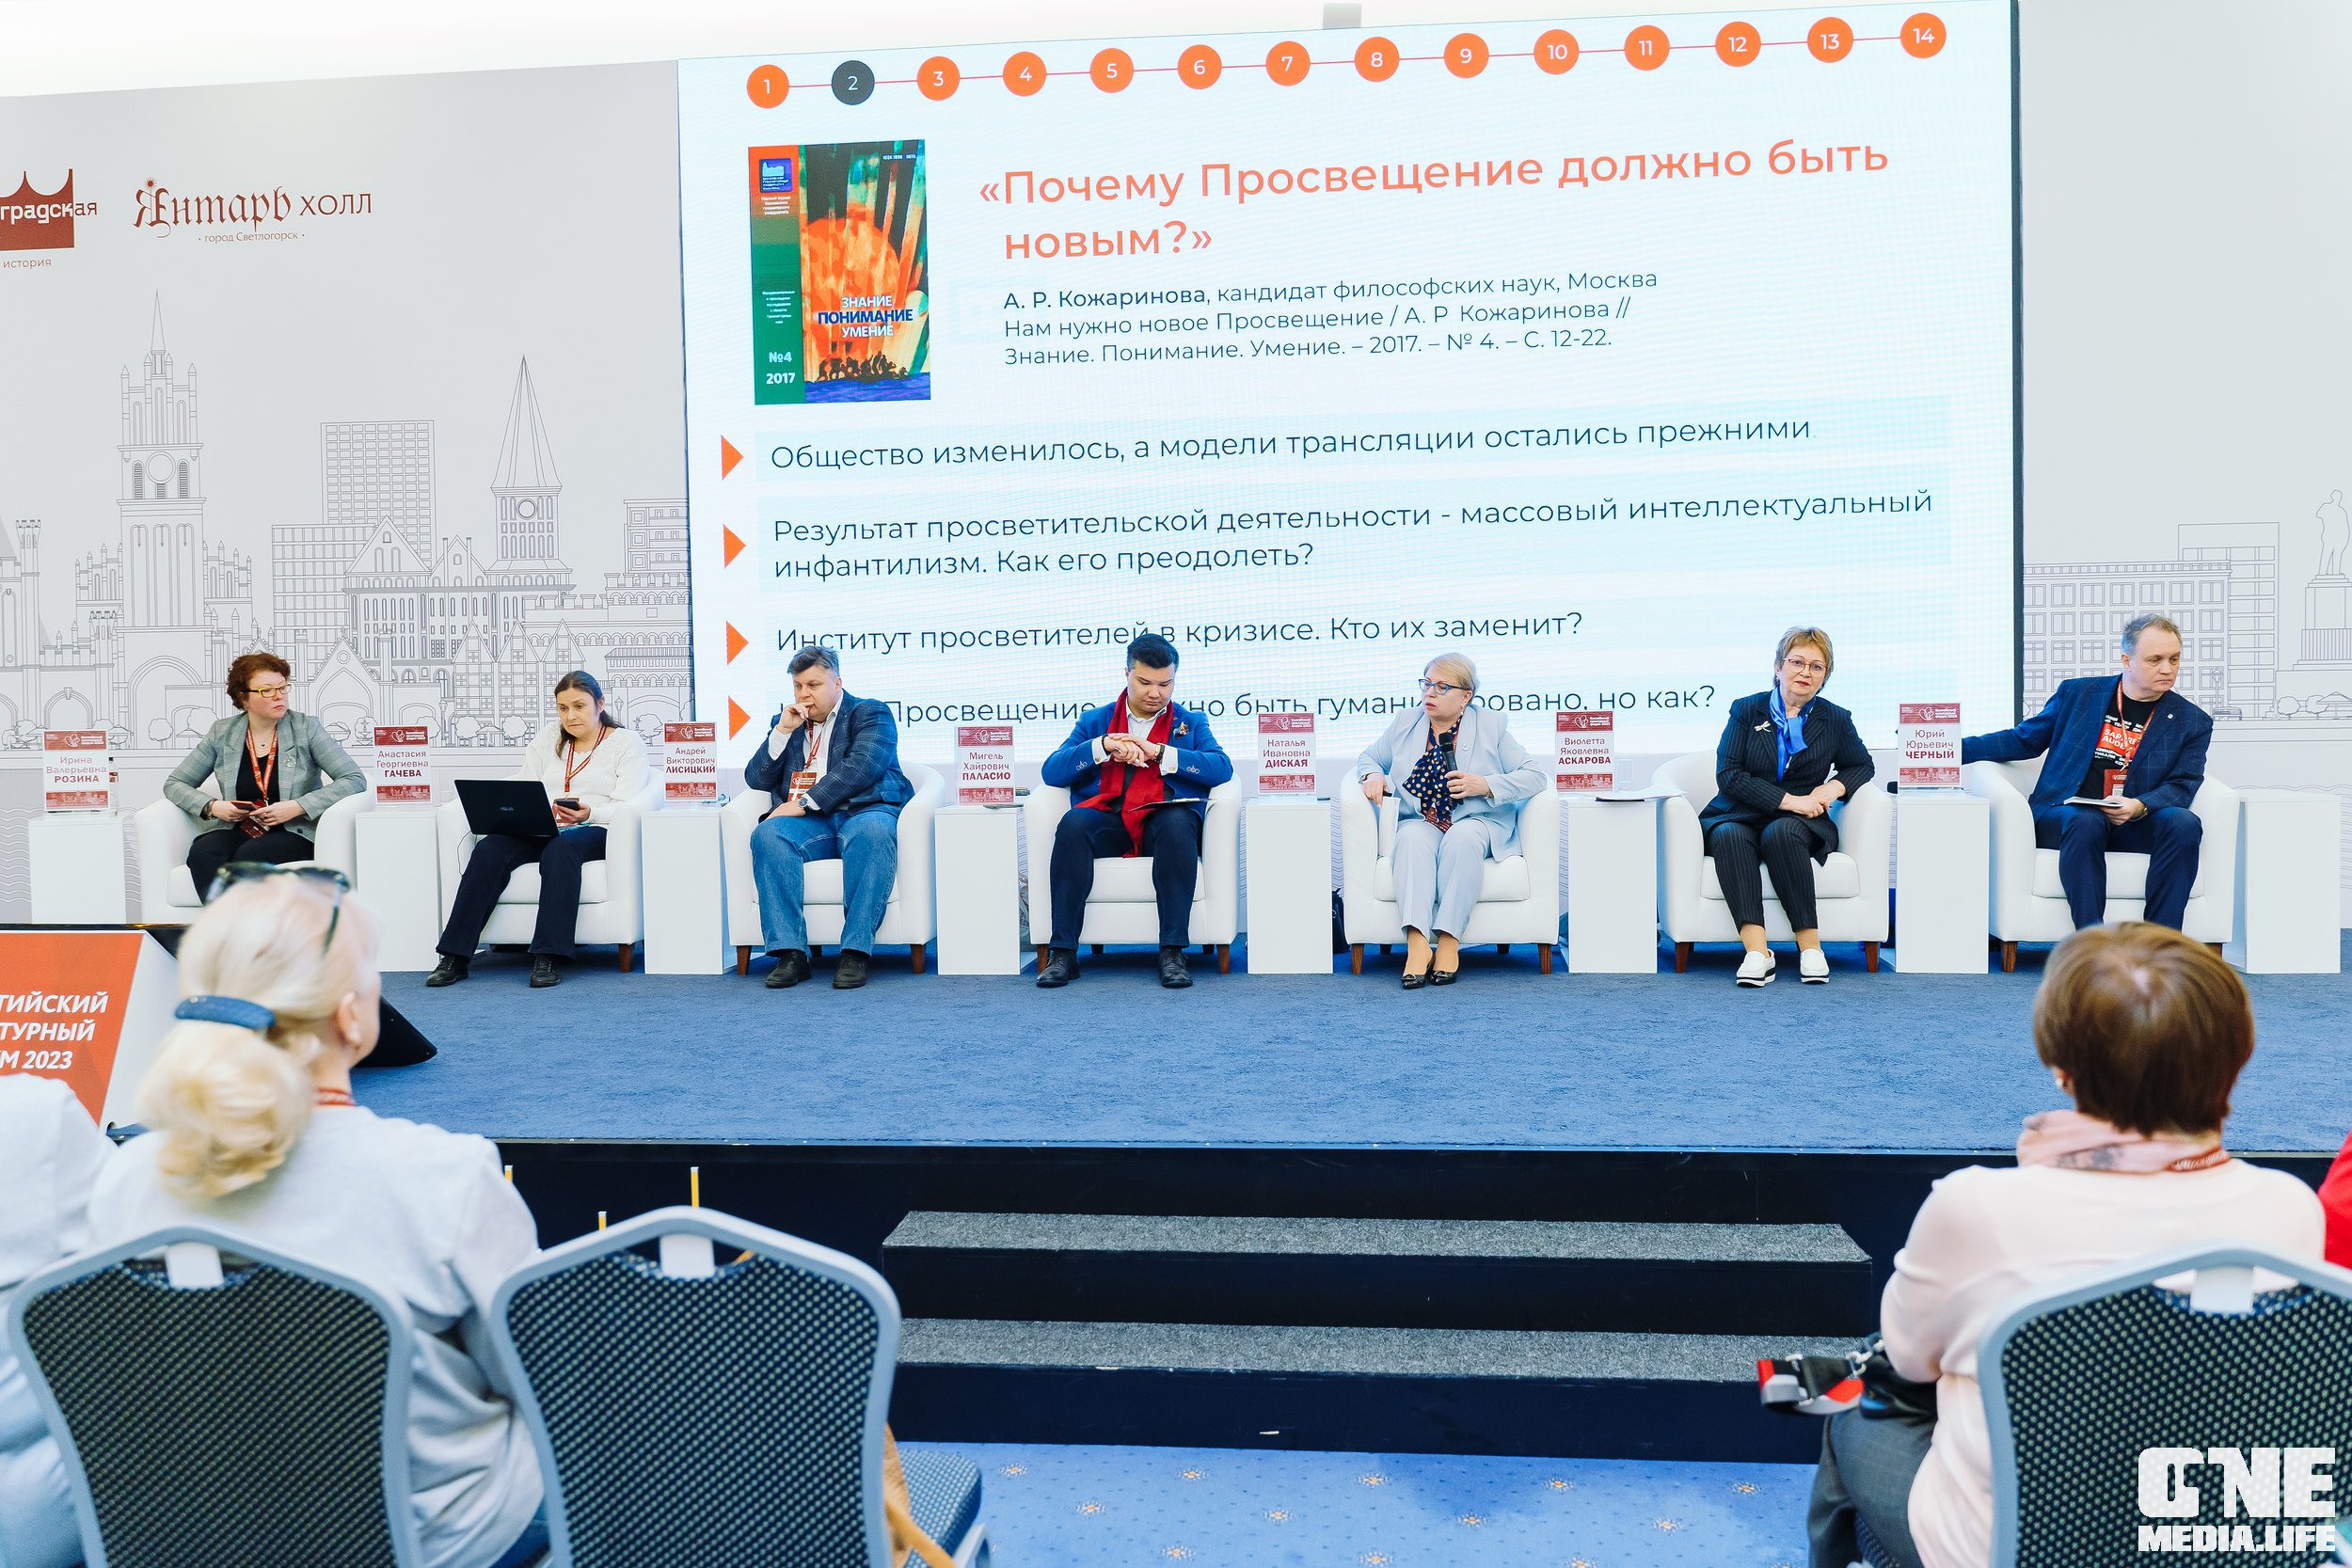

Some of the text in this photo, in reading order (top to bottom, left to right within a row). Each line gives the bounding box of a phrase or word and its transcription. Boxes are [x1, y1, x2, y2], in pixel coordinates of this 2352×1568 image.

[765, 28, 1934, 93] 1 2 3 4 5 6 7 8 9 10 11 12 13 14
[980, 139, 1887, 207] «Почему Просвещение должно быть
[205, 232, 299, 244] город Светлогорск
[1006, 220, 1212, 259] новым?»
[4, 260, 51, 269] история
[1004, 273, 1656, 309] А. Р. Кожаринова, кандидат философских наук, Москва
[841, 295, 894, 309] ЗНАНИЕ
[818, 309, 914, 325] ПОНИМАНИЕ
[1006, 321, 1050, 337] Нам
[1060, 321, 1131, 339] нужно
[1140, 318, 1208, 332] новое
[1217, 312, 1383, 333] Просвещение
[1391, 305, 1398, 326] /
[1405, 308, 1425, 324] А.
[1461, 305, 1608, 324] Кожаринова
[841, 325, 895, 338] УМЕНИЕ
[1006, 349, 1093, 364] Знание.
[1104, 345, 1243, 361] Понимание.
[1250, 341, 1344, 356] Умение.
[1370, 336, 1421, 353] 2017.
[1448, 334, 1471, 350] №
[1480, 333, 1498, 349] 4.
[1525, 331, 1544, 347] С.
[1551, 329, 1611, 346] 12-22.
[769, 352, 792, 362] №4
[767, 372, 795, 384] 2017
[771, 445, 923, 469] Общество
[934, 442, 1124, 464] изменилось,
[1135, 441, 1149, 457] а
[1161, 437, 1276, 459] модели
[1290, 430, 1473, 458] трансляции
[1486, 427, 1627, 448] остались
[775, 521, 917, 546] Результат
[929, 509, 1206, 543] просветительской
[1217, 509, 1430, 533] деятельности
[1462, 498, 1616, 523] массовый
[1630, 489, 1931, 520] интеллектуальный
[776, 544, 1312, 582] инфантилизм. Как его преодолеть?
[779, 629, 912, 655] Институт
[1161, 626, 1175, 643] в
[1187, 624, 1319, 647] кризисе.
[1332, 618, 1379, 639] Кто
[1391, 621, 1424, 638] их
[1435, 612, 1581, 637] заменит?
[1235, 693, 1308, 716] быть
[1598, 691, 1636, 710] но
[1648, 686, 1714, 707] как?
[1915, 729, 1945, 739] Юрий
[2104, 728, 2137, 745] SAPRE
[1565, 737, 1605, 746] Виолетта
[1906, 740, 1954, 750] Юрьевич
[675, 747, 706, 755] Андрей
[970, 752, 1004, 760] Мигель
[1560, 747, 1610, 755] Яковлевна
[1905, 749, 1954, 759] ЧЕРНЫЙ
[60, 756, 92, 765] Ирина
[377, 760, 429, 768] Георгиевна
[963, 762, 1009, 771] Хайрович
[1265, 759, 1308, 768] ДИСКАЯ
[1558, 756, 1612, 765] АСКАРОВА
[385, 769, 421, 778] ГАЧЕВА
[666, 764, 715, 774] ЛИСИЦКИЙ
[55, 775, 99, 784] РОЗИНА
[0, 1020, 95, 1040] ТУРНЫЙ
[23, 1051, 72, 1069] 2023
